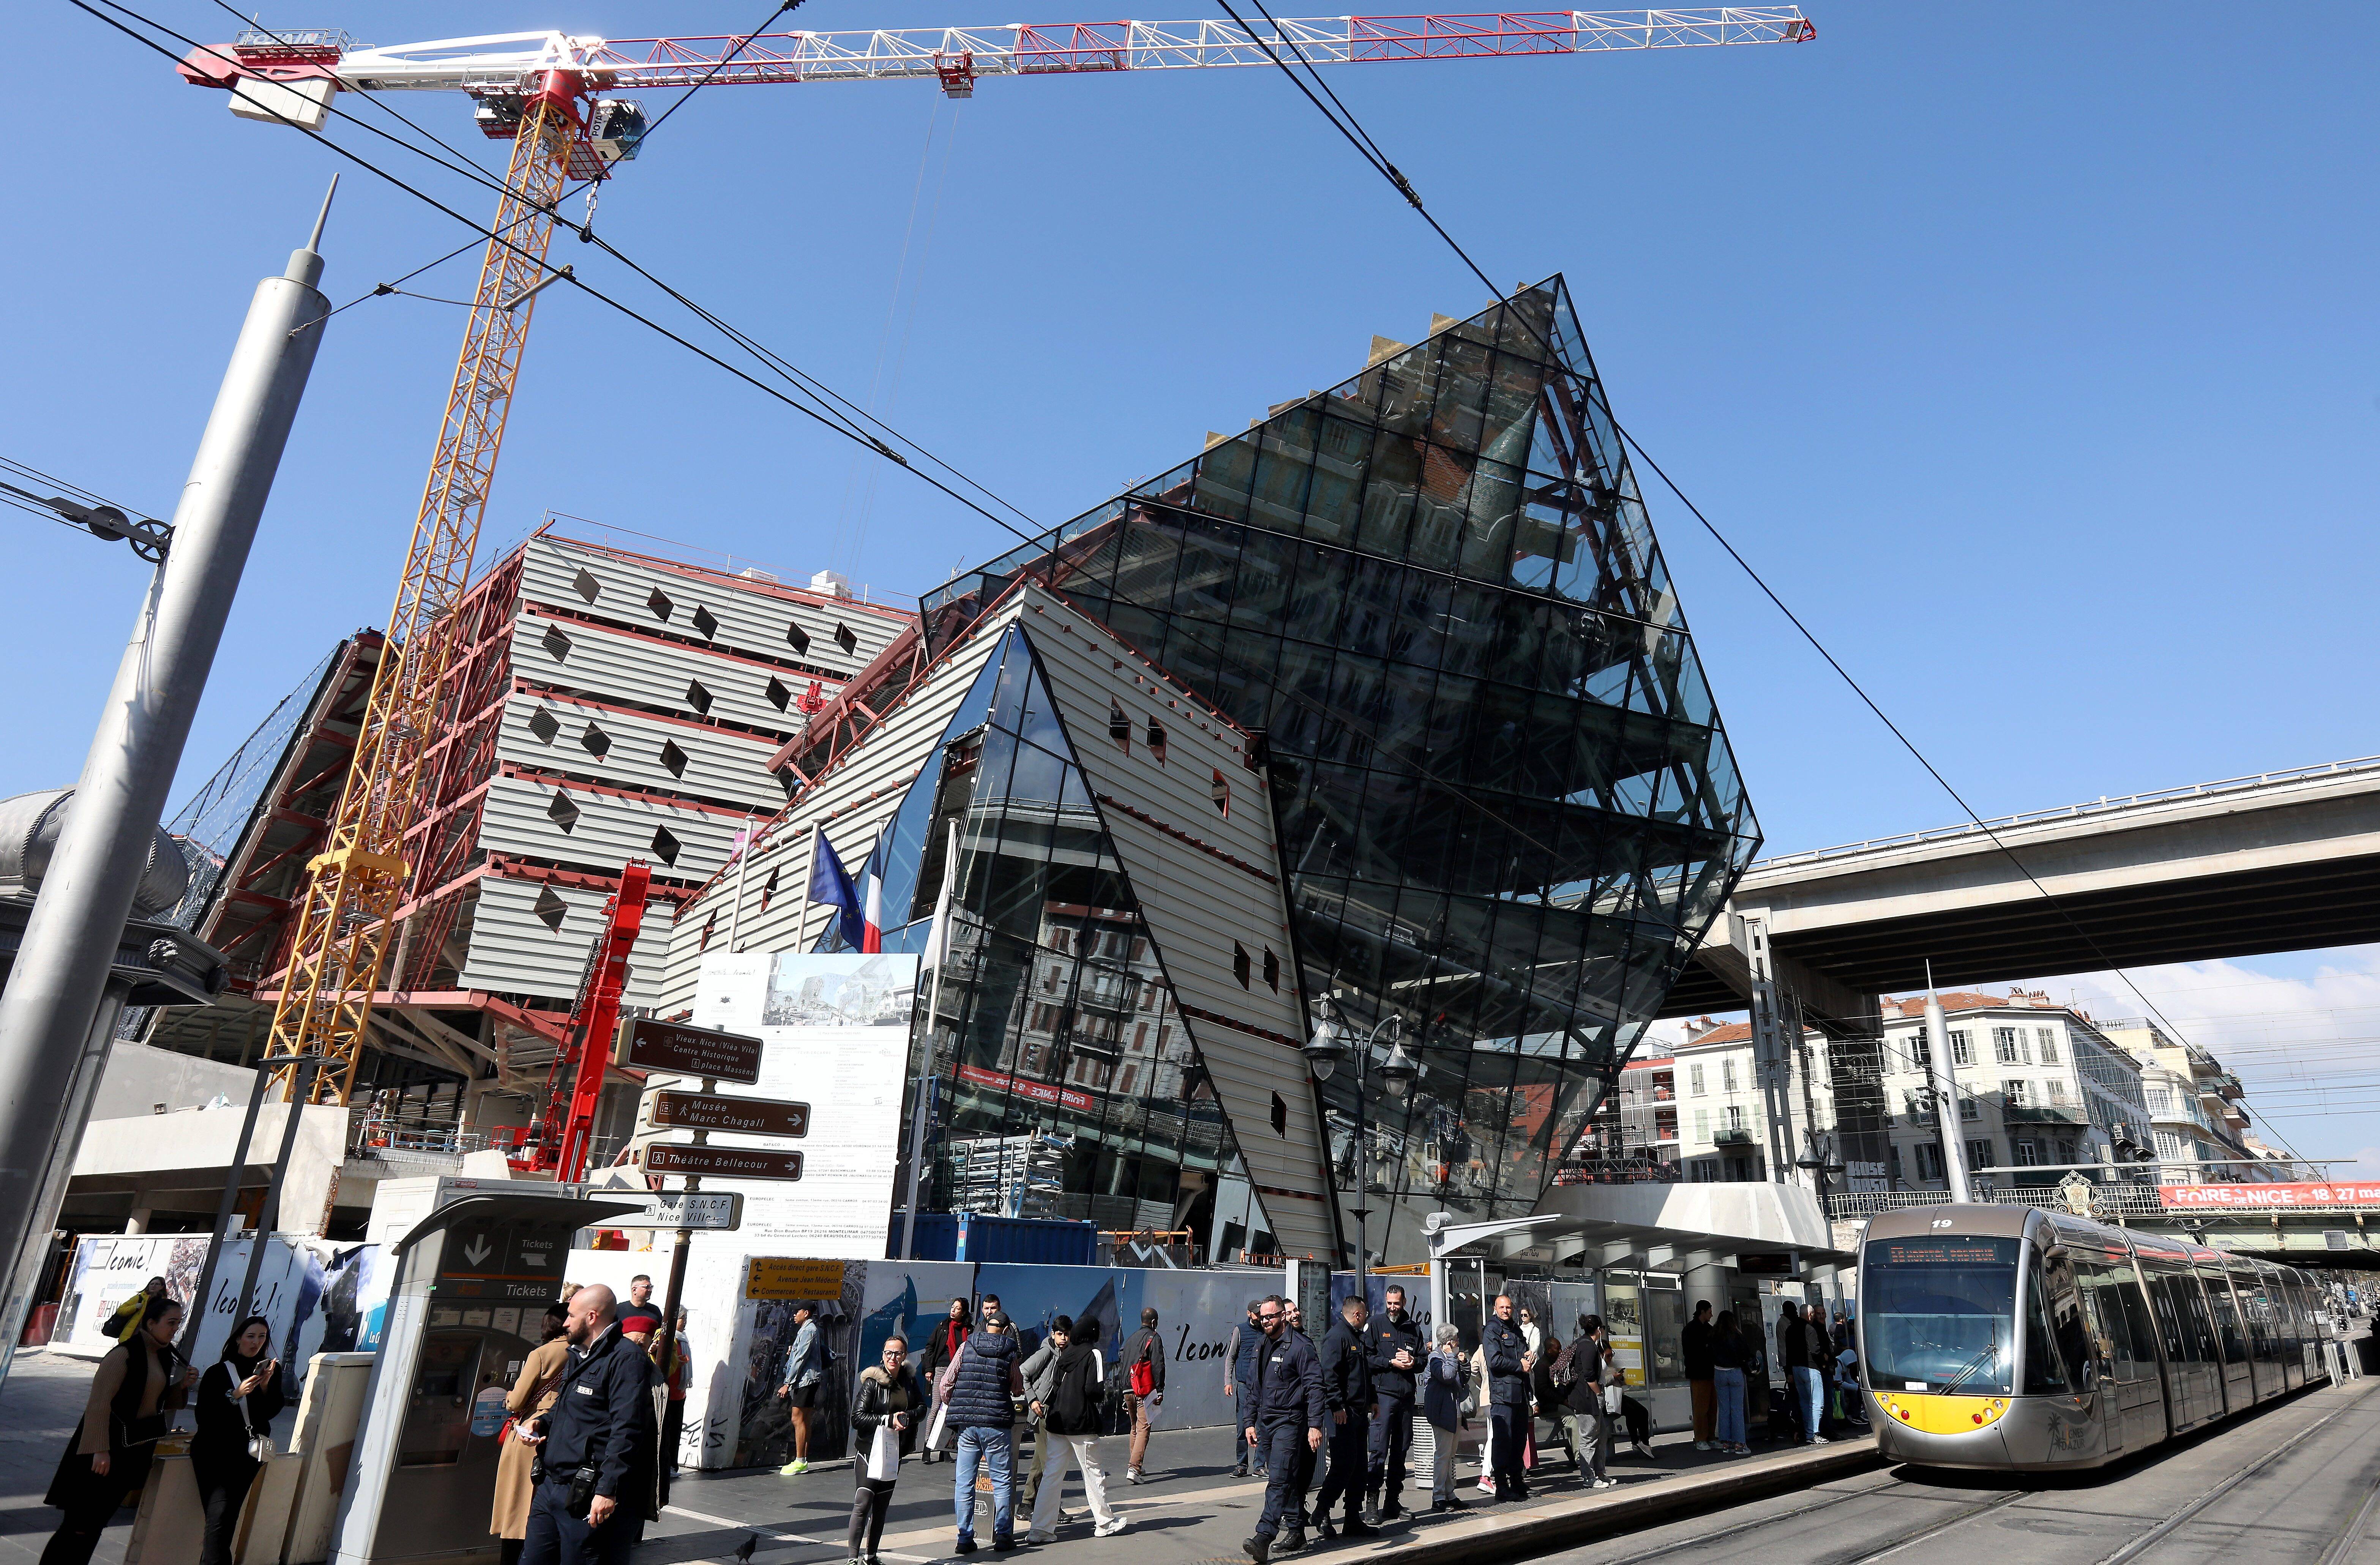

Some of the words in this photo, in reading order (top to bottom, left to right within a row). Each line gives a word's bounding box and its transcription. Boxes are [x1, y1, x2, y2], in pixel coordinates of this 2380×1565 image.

[676, 1034, 696, 1044] Vieux
[699, 1038, 716, 1047] Nice
[742, 1045, 758, 1055] Vila)
[674, 1045, 698, 1055] Centre
[702, 1049, 739, 1062] Historique
[701, 1062, 721, 1070] place
[724, 1065, 754, 1076] Masséna
[691, 1101, 727, 1112] Musée
[690, 1113, 717, 1123] Marc
[723, 1115, 765, 1128] Chagall
[669, 1154, 709, 1165] Théâtre
[715, 1157, 768, 1169] Bellecour
[2175, 1187, 2232, 1202] FOIRE
[2247, 1189, 2295, 1204] NICE
[2311, 1188, 2329, 1201] 18
[2337, 1188, 2355, 1201] 27
[660, 1199, 683, 1208] Gare
[690, 1200, 728, 1209] S.N.C.F.
[657, 1212, 680, 1221] Nice
[687, 1213, 710, 1221] Ville
[1932, 1219, 1952, 1228] 19
[522, 1239, 553, 1249] Tickets
[104, 1239, 157, 1272] Iconic!
[507, 1284, 547, 1297] Tickets
[213, 1278, 278, 1319] Icoic!
[104, 1300, 122, 1317] Hil
